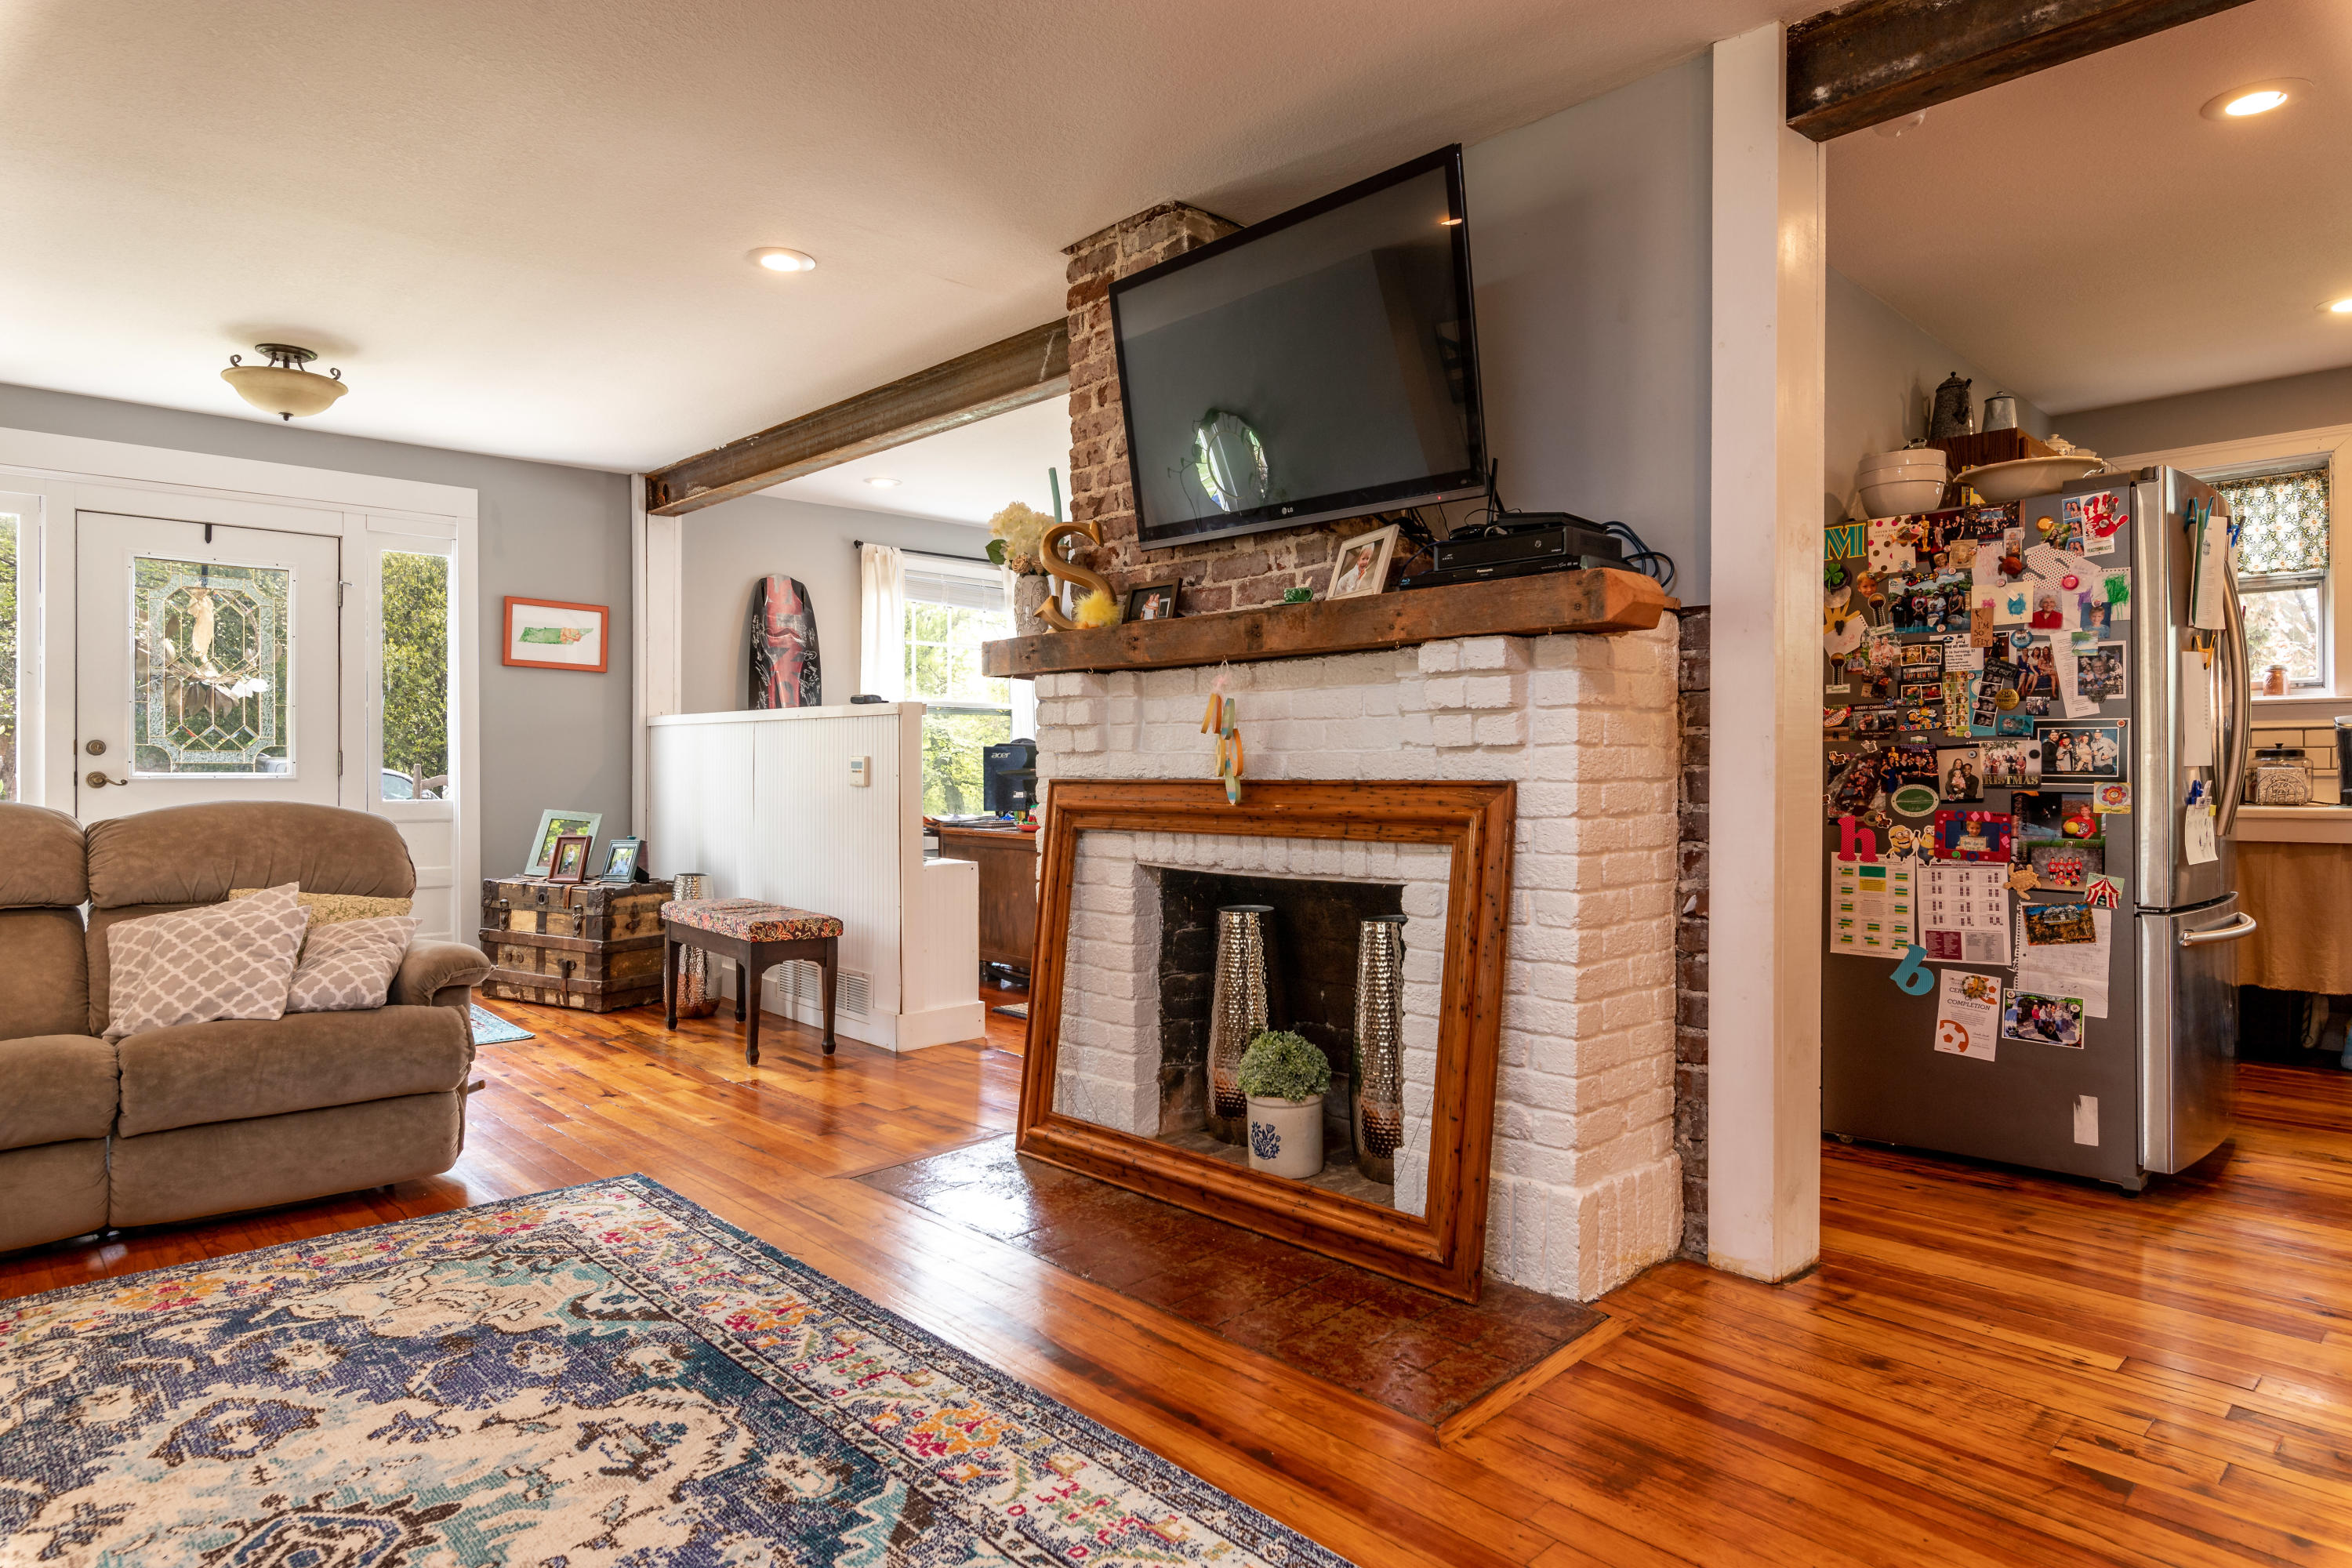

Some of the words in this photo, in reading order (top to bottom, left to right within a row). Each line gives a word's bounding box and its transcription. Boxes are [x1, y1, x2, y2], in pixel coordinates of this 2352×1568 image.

[1824, 523, 1867, 561] M
[1033, 520, 1117, 632] S
[1983, 775, 2038, 785] RISTMAS
[1837, 815, 1879, 862] h
[1947, 998, 1991, 1011] COMPLETION
